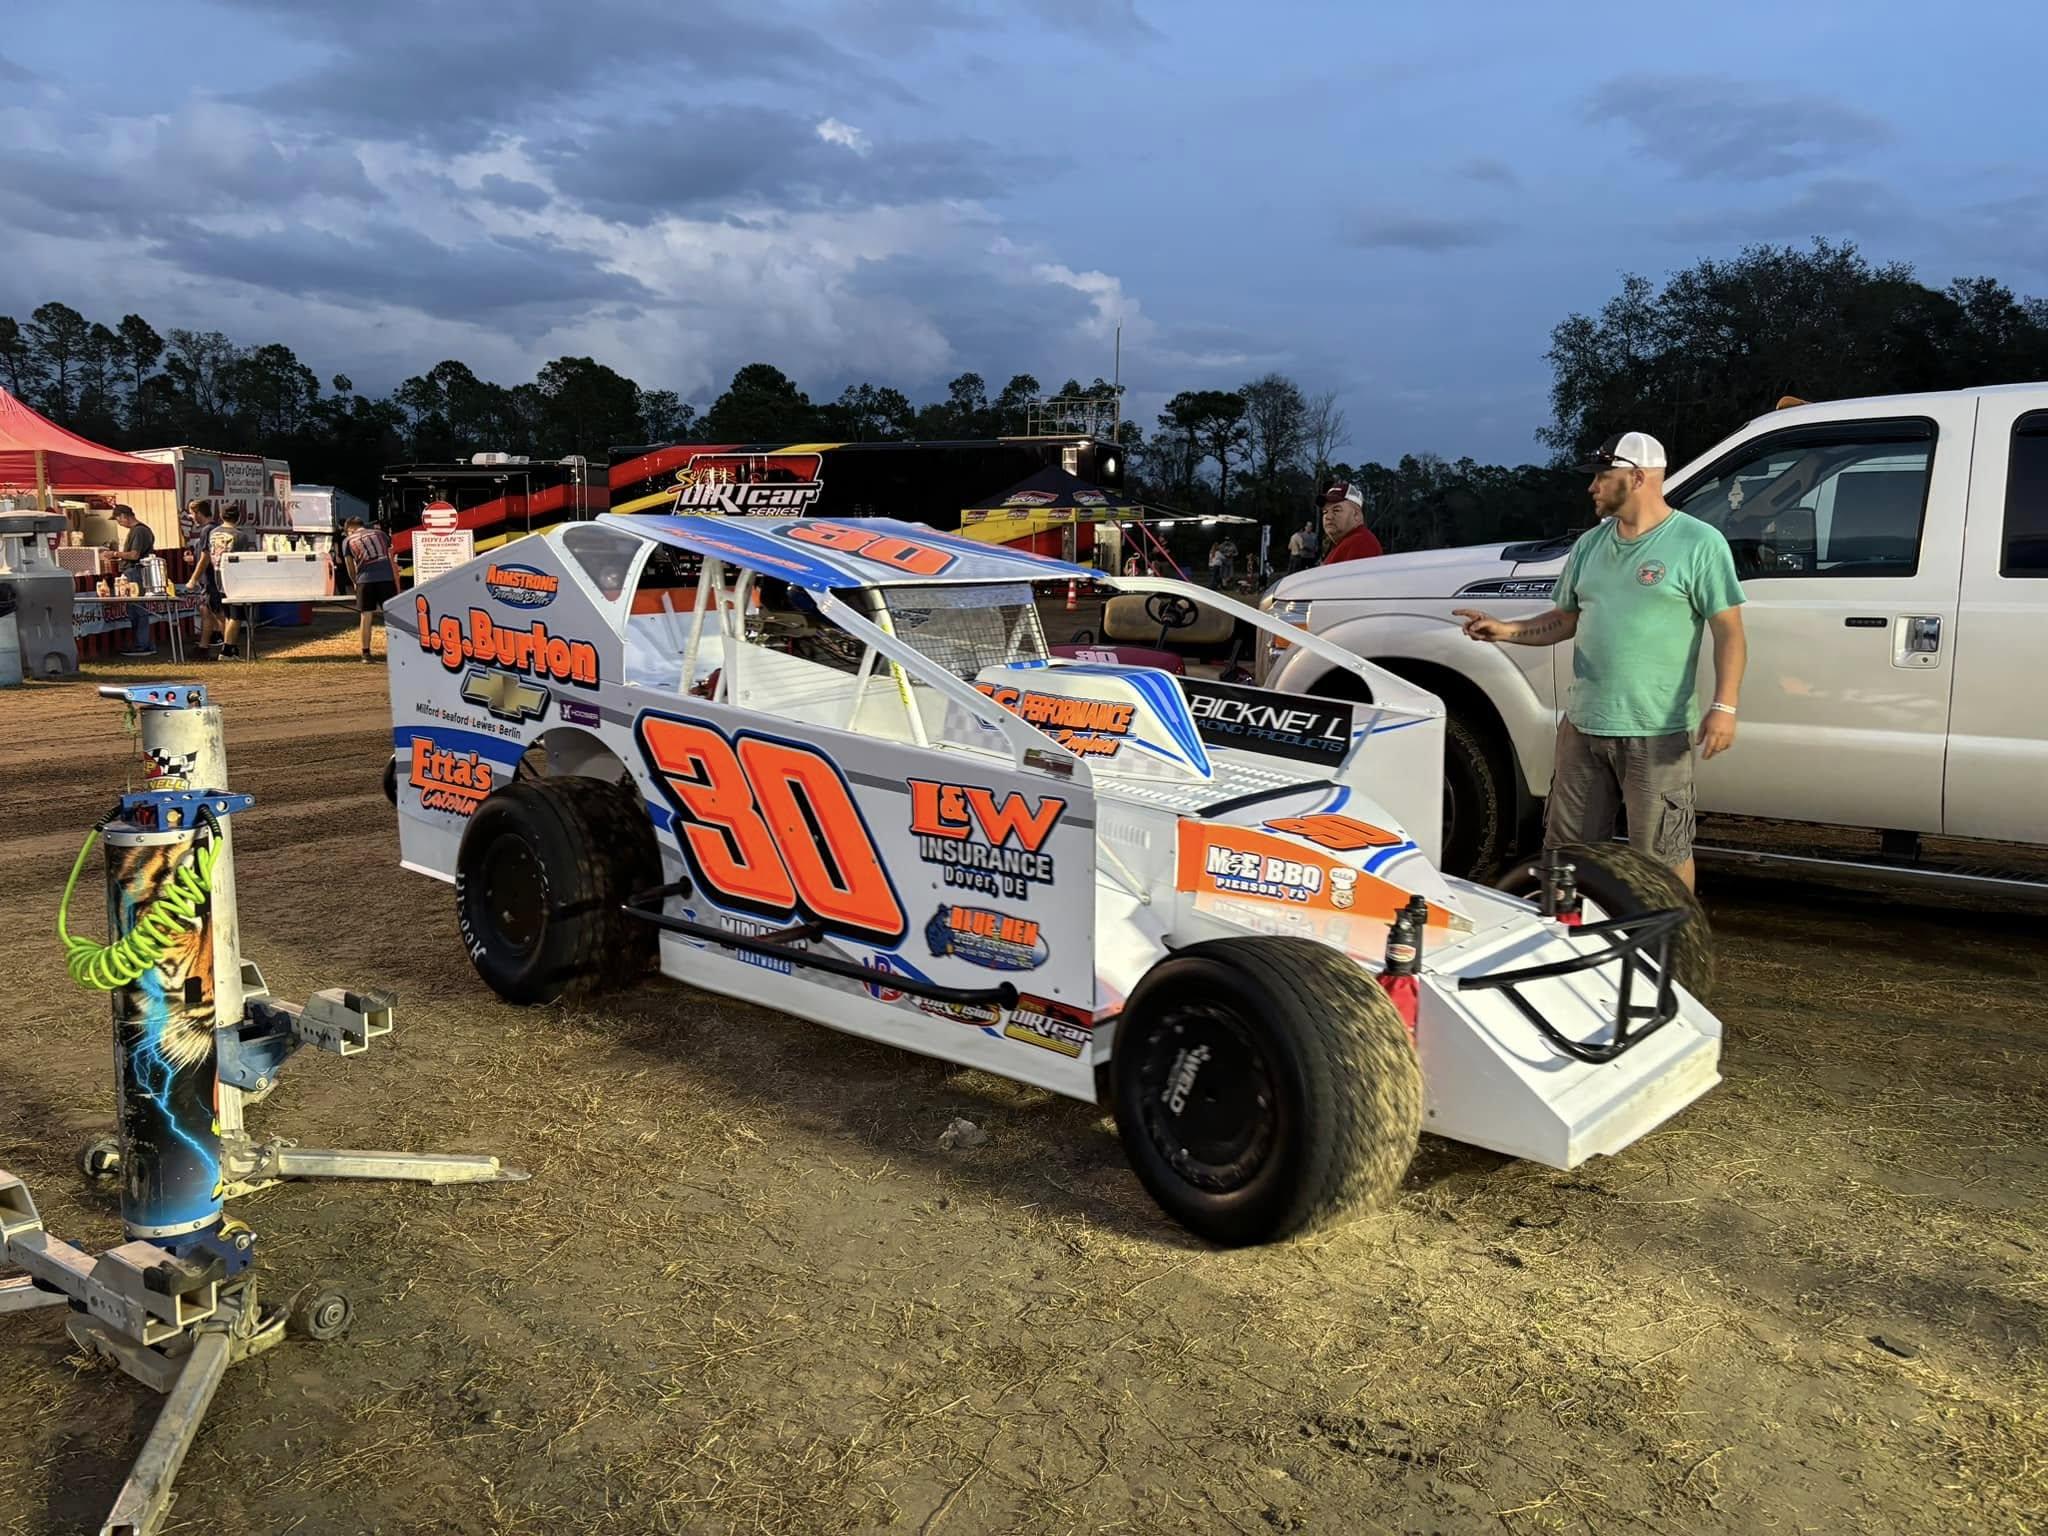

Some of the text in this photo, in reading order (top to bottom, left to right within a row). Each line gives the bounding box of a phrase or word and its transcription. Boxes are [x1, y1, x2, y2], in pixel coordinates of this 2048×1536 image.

[680, 484, 816, 512] DIRTcar
[746, 507, 800, 516] SERIES
[776, 520, 957, 577] 30
[487, 564, 558, 592] ARMSTRONG
[1075, 651, 1119, 664] 30
[416, 702, 521, 740] Milford Seaford Lewes Berlin
[1022, 691, 1135, 734] PERFORMANCE
[1197, 719, 1344, 752] ACING PRODUCTS
[410, 736, 492, 792] Etta's
[420, 785, 479, 816] Caterin
[907, 778, 1066, 853] L&W
[639, 712, 906, 938] 30
[1263, 814, 1402, 850] 30
[920, 836, 1053, 884] INSURANCE
[1208, 846, 1322, 893] M&E BBQ
[945, 866, 1027, 898] Dover, DE
[1216, 877, 1307, 901] PIERSON, FL
[951, 906, 1039, 946] BLUE HEN
[1013, 1008, 1093, 1044] DIRTcar
